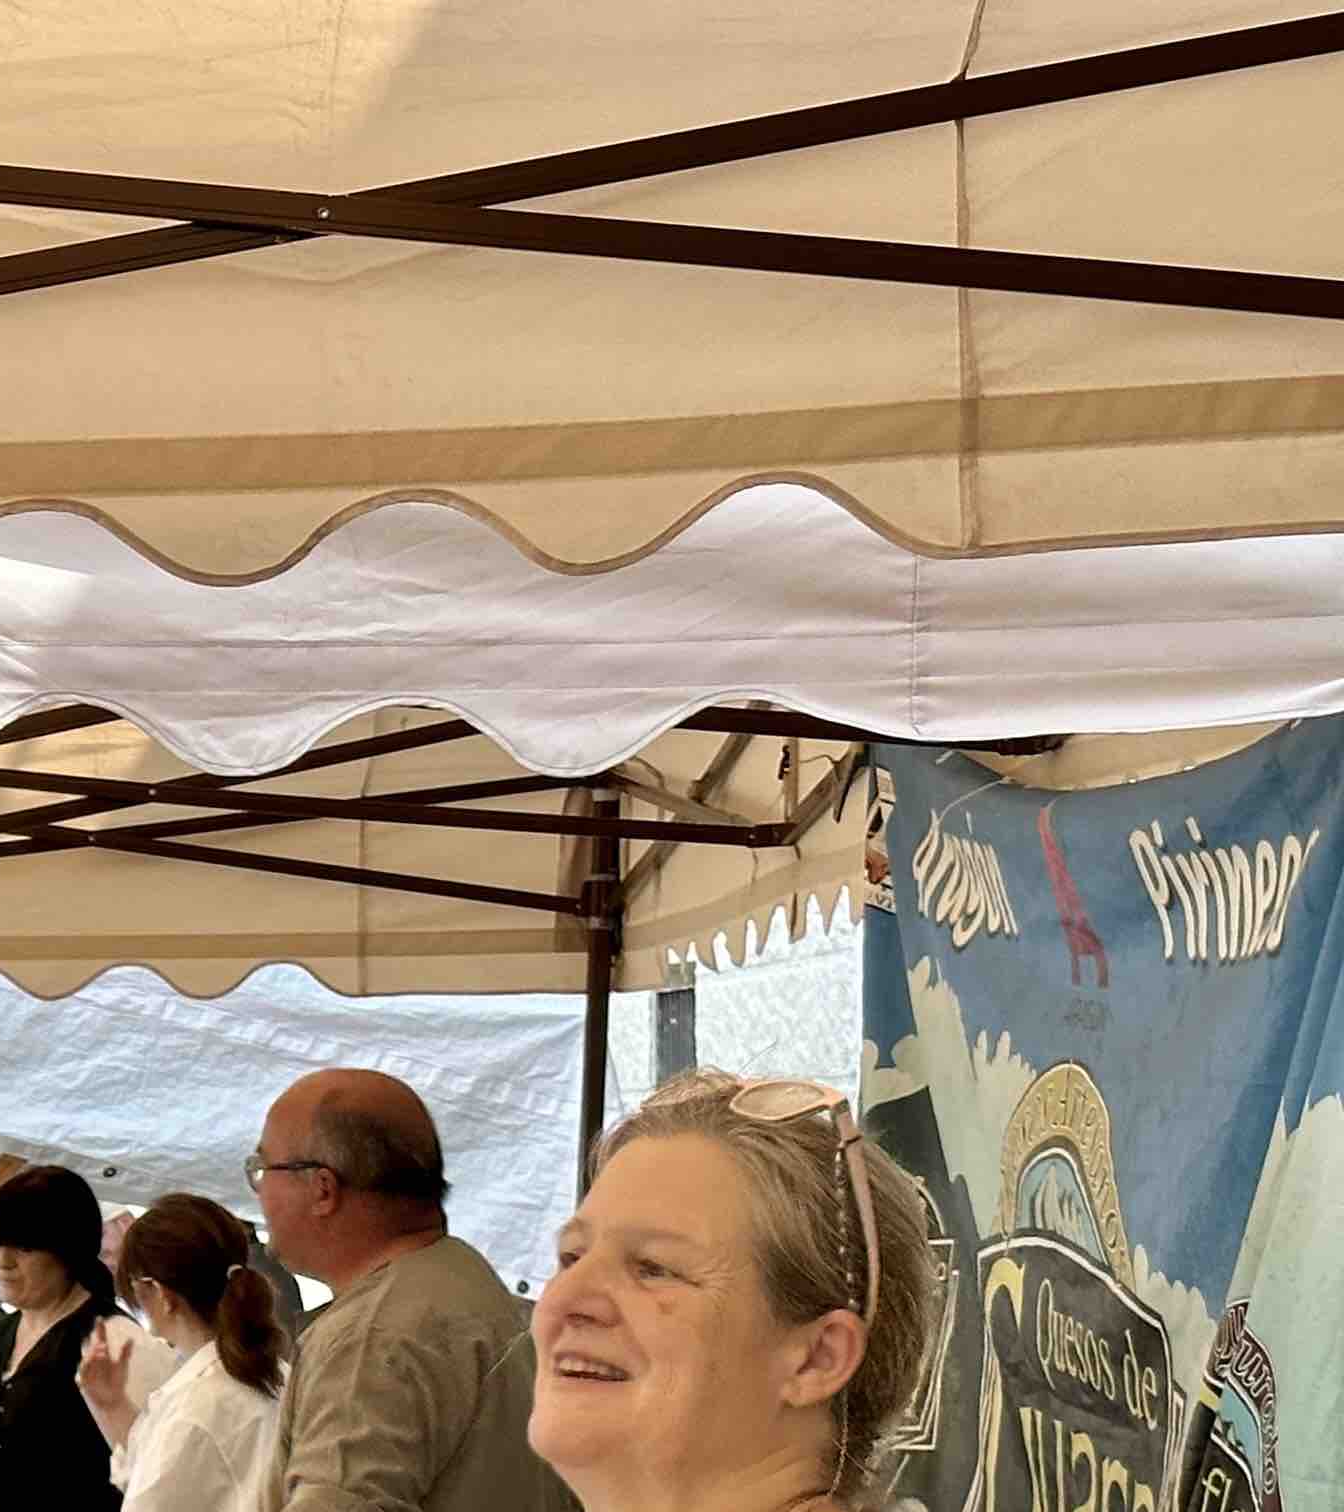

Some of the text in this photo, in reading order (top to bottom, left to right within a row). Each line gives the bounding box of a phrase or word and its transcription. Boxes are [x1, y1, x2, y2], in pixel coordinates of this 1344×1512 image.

[1128, 814, 1320, 961] Pirineo
[1037, 1277, 1159, 1431] Quesos de
